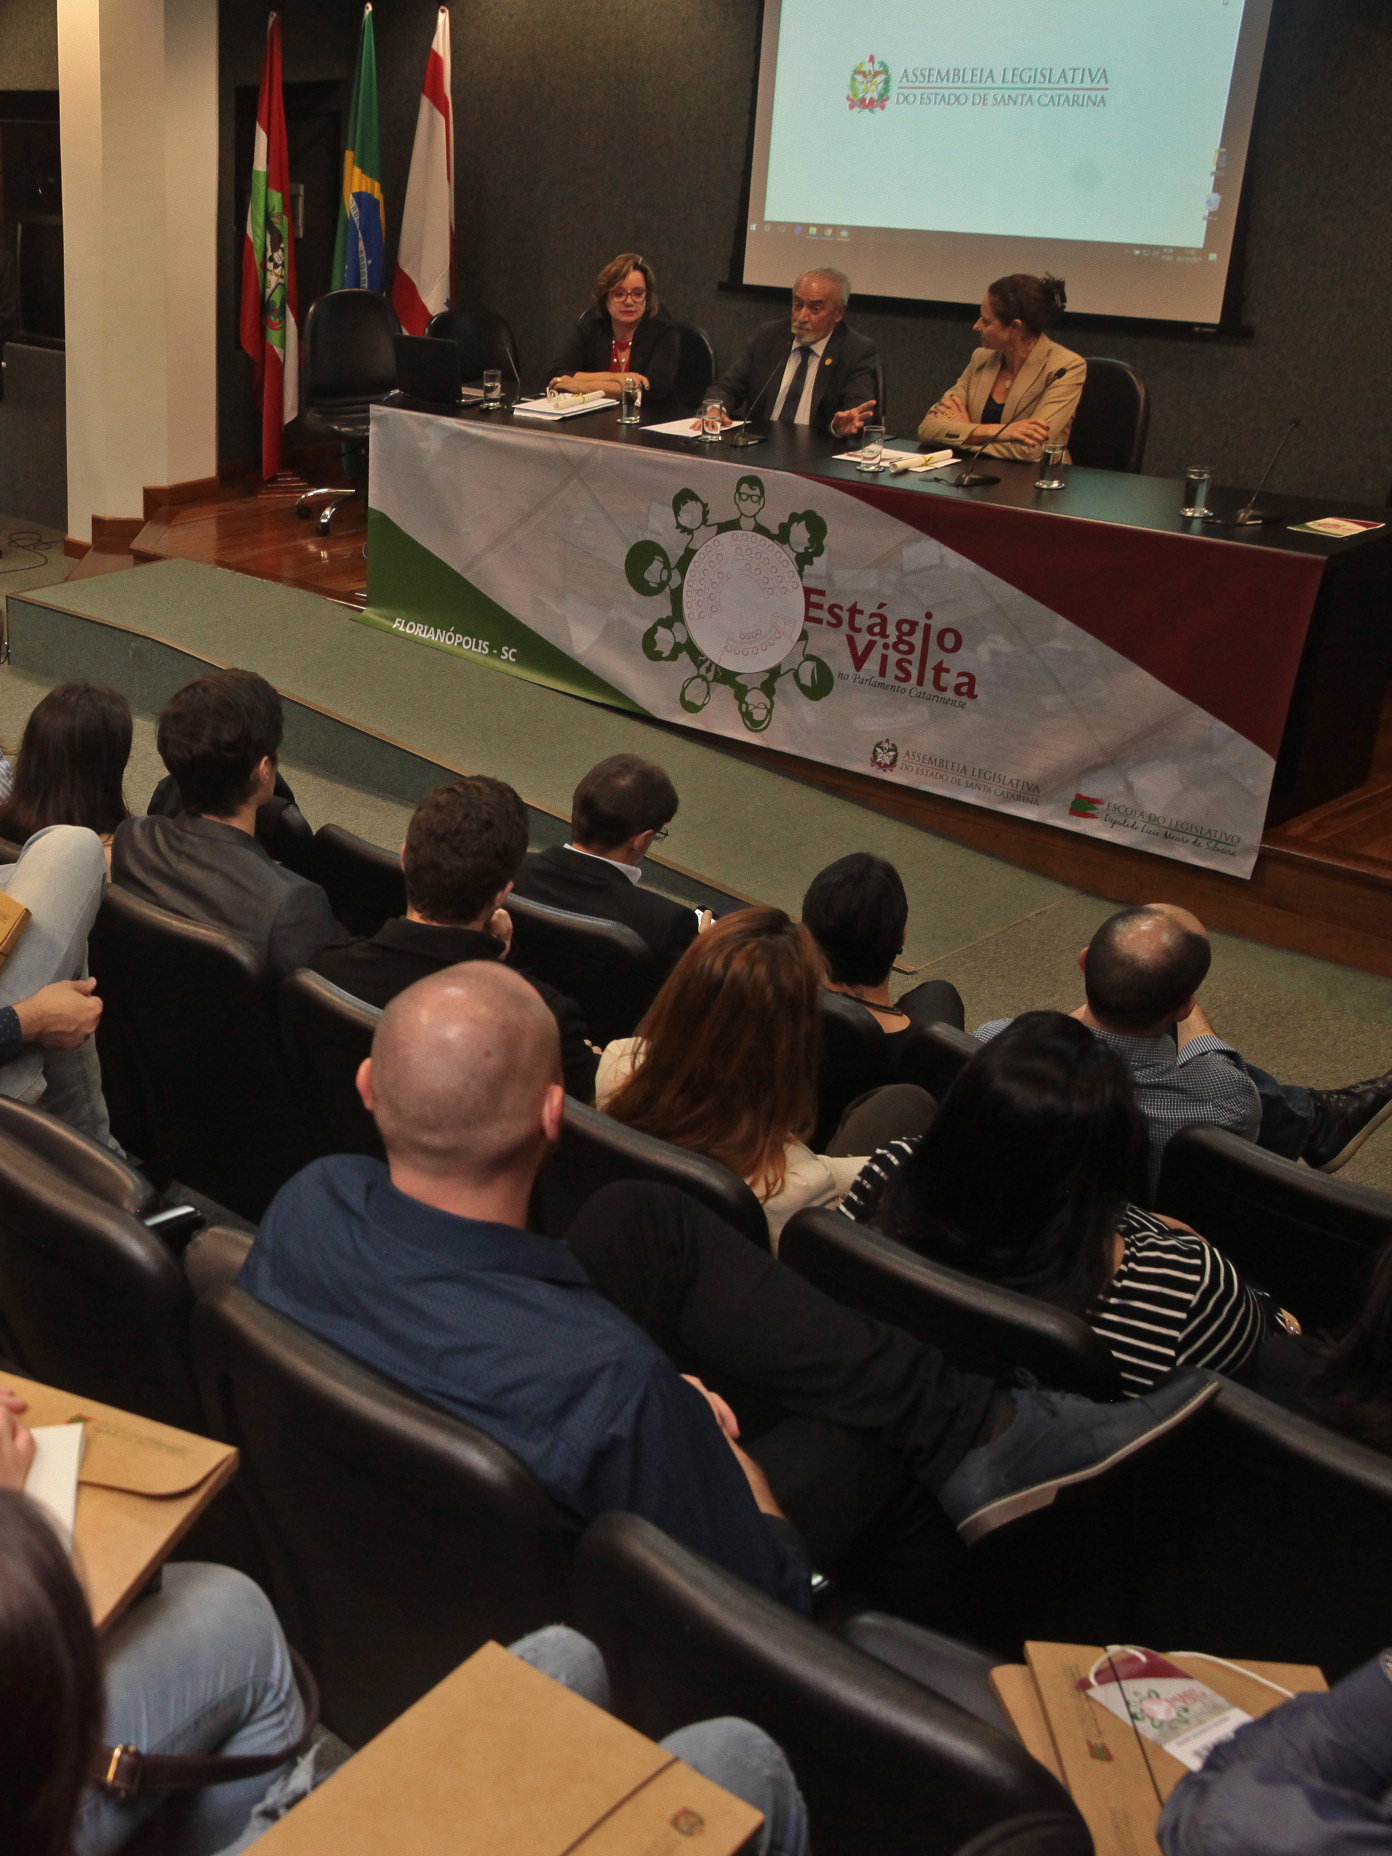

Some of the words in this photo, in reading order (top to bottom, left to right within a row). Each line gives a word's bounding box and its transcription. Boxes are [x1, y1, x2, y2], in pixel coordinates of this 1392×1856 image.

[899, 67, 995, 84] ASSEMBLEIA
[1001, 67, 1110, 85] LEGISLATIVA
[895, 92, 916, 105] DO
[919, 92, 968, 106] ESTADO
[971, 93, 991, 106] DE
[992, 93, 1034, 107] SANTA
[1036, 94, 1107, 108] CATARINA
[392, 618, 490, 654] FLORIANÓPOLIS
[500, 646, 518, 662] SC
[803, 586, 963, 656] Estágio
[845, 633, 979, 700] Visita
[837, 671, 850, 682] no
[851, 674, 907, 695] Parlamento
[908, 687, 968, 709] Catarinense
[900, 763, 913, 772] DO
[915, 767, 948, 782] ESTADO
[951, 776, 962, 786] DE
[965, 780, 992, 794] SANTA
[993, 788, 1040, 807] CATARINA
[903, 750, 967, 775] ASSEMBLEIA
[971, 767, 1041, 794] LEGISLATIVA
[1106, 801, 1145, 820] ESCOLA
[1148, 812, 1166, 825] DO
[1169, 818, 1241, 845] LEGISLATIVO
